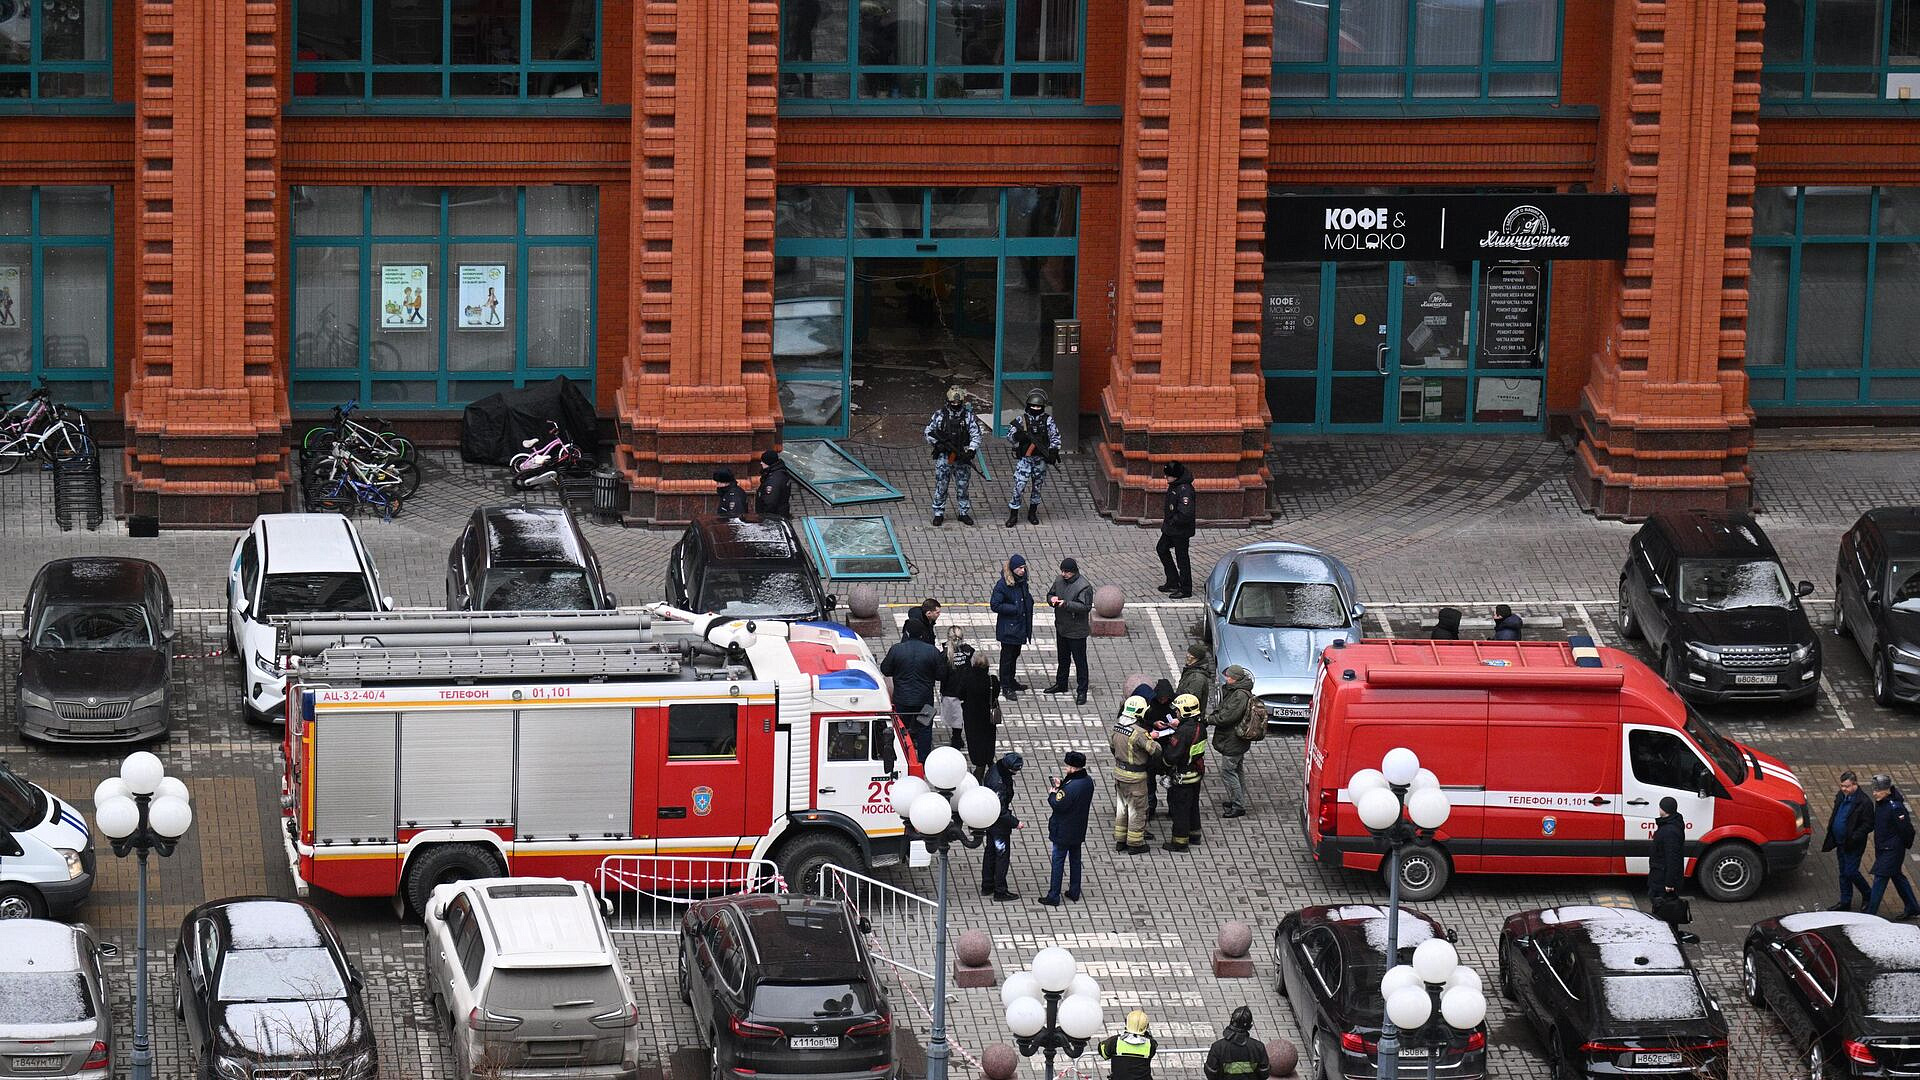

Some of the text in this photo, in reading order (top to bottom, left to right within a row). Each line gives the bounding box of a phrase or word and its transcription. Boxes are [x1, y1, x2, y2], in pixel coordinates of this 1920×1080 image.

[1324, 208, 1407, 230] КОФЕ &
[1323, 232, 1406, 251] MOLOKO
[1479, 229, 1571, 248] Химчистка
[1269, 297, 1294, 306] КОФЕ
[323, 690, 386, 702] АЦ-3,2-40/4
[439, 688, 572, 701] ТЕЛЕФОН 01,101
[1508, 796, 1552, 805] ТЕЛЕФОН
